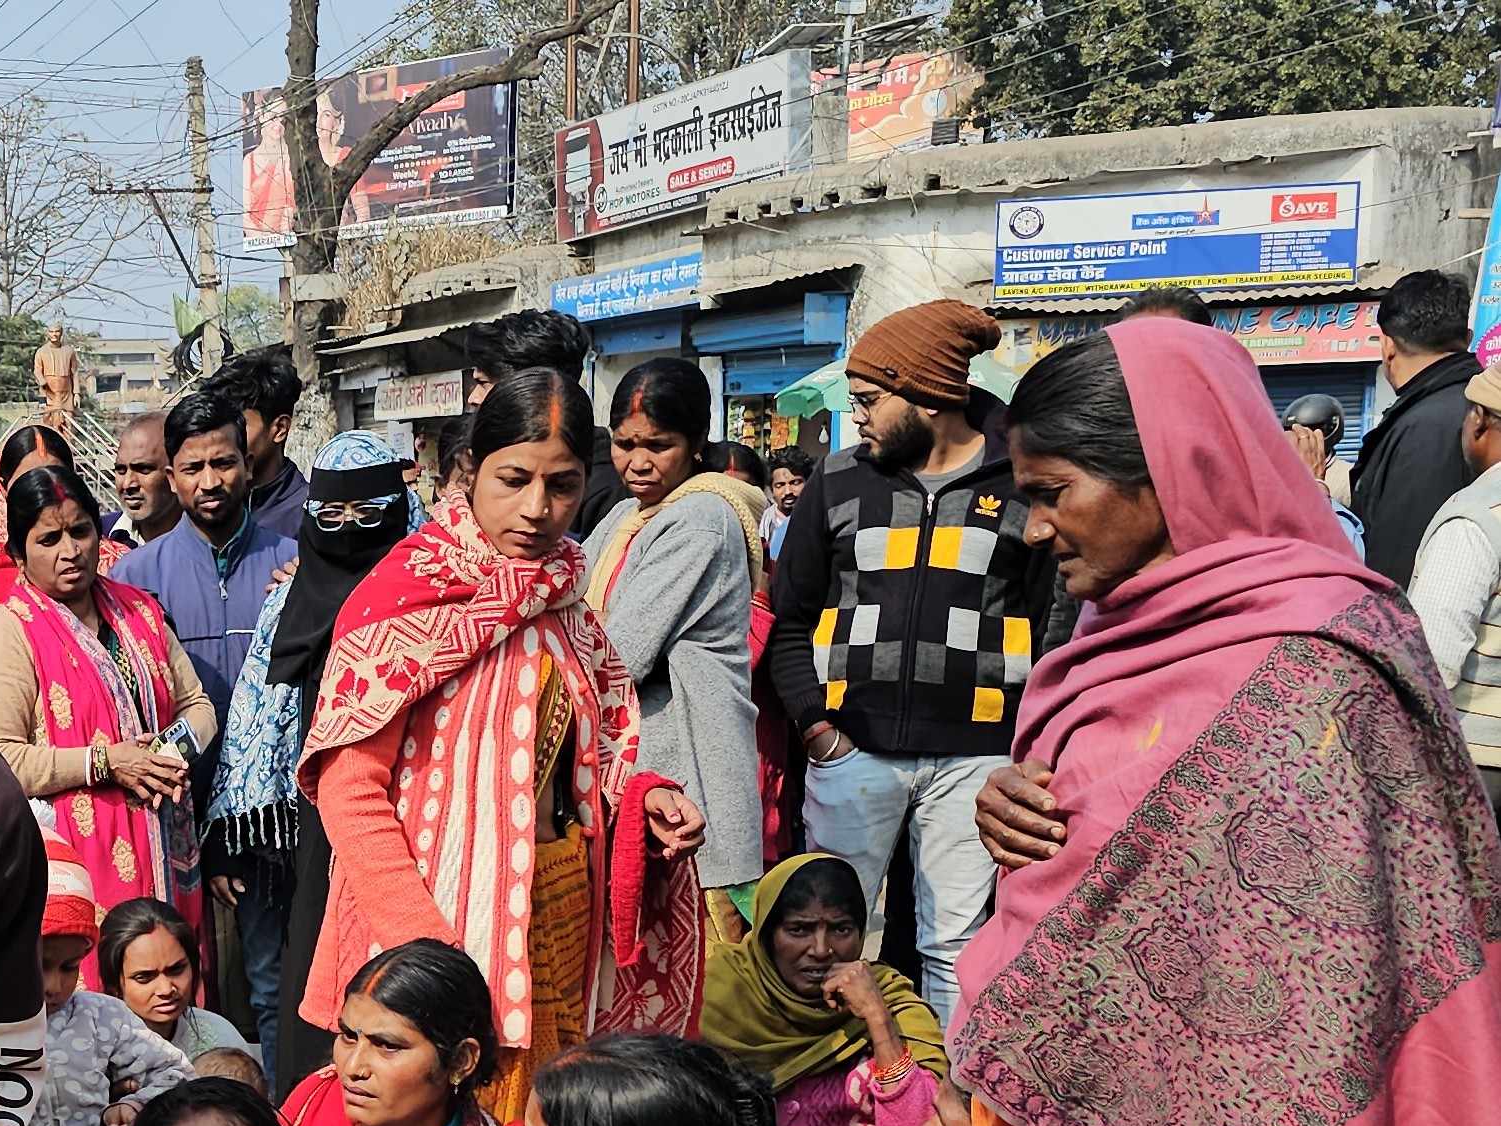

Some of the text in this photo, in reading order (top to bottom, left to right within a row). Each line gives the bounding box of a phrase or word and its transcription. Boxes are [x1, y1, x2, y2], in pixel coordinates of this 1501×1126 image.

[608, 138, 630, 176] जय
[669, 171, 691, 188] SALE
[691, 169, 698, 184] &
[698, 159, 734, 182] SERVICE
[1279, 198, 1329, 217] SAVE
[1002, 240, 1168, 263] Customer Service Point
[1046, 267, 1078, 282] सेवा
[1269, 302, 1360, 333] CAFE
[1250, 337, 1303, 347] REPAIRING
